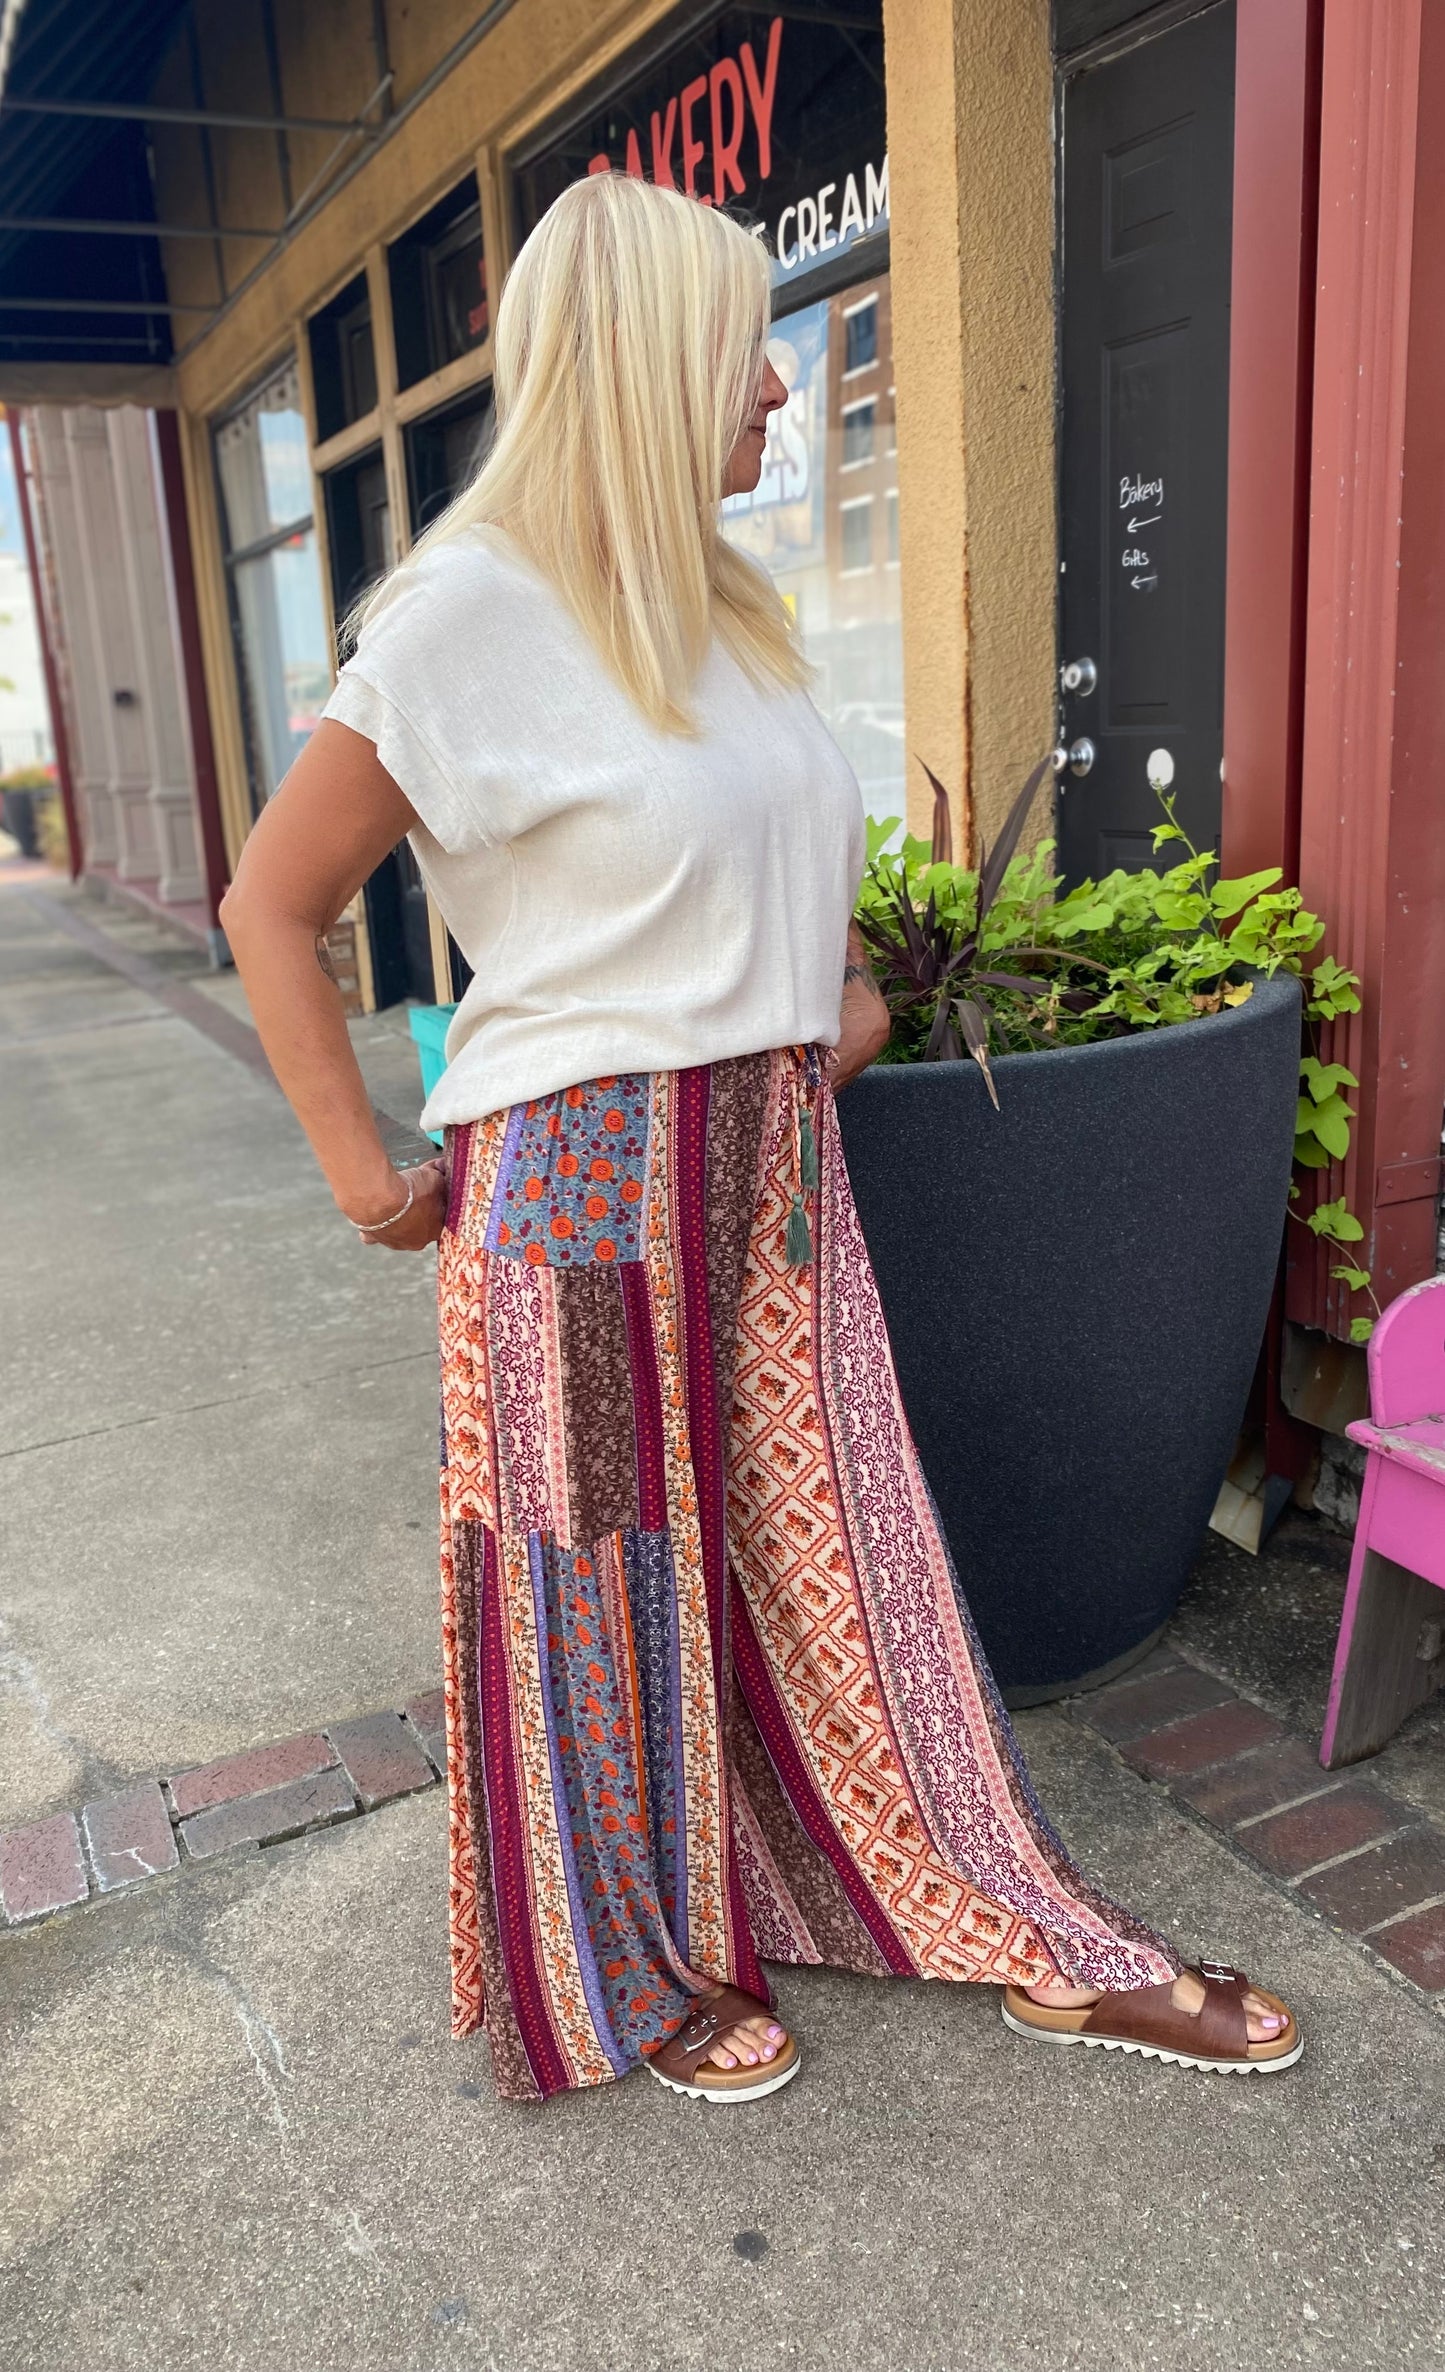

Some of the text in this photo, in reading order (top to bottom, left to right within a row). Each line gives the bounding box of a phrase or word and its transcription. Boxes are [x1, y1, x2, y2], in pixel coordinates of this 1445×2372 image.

[588, 17, 783, 207] KERY
[777, 153, 890, 269] CREAM
[1119, 473, 1163, 509] Bakery
